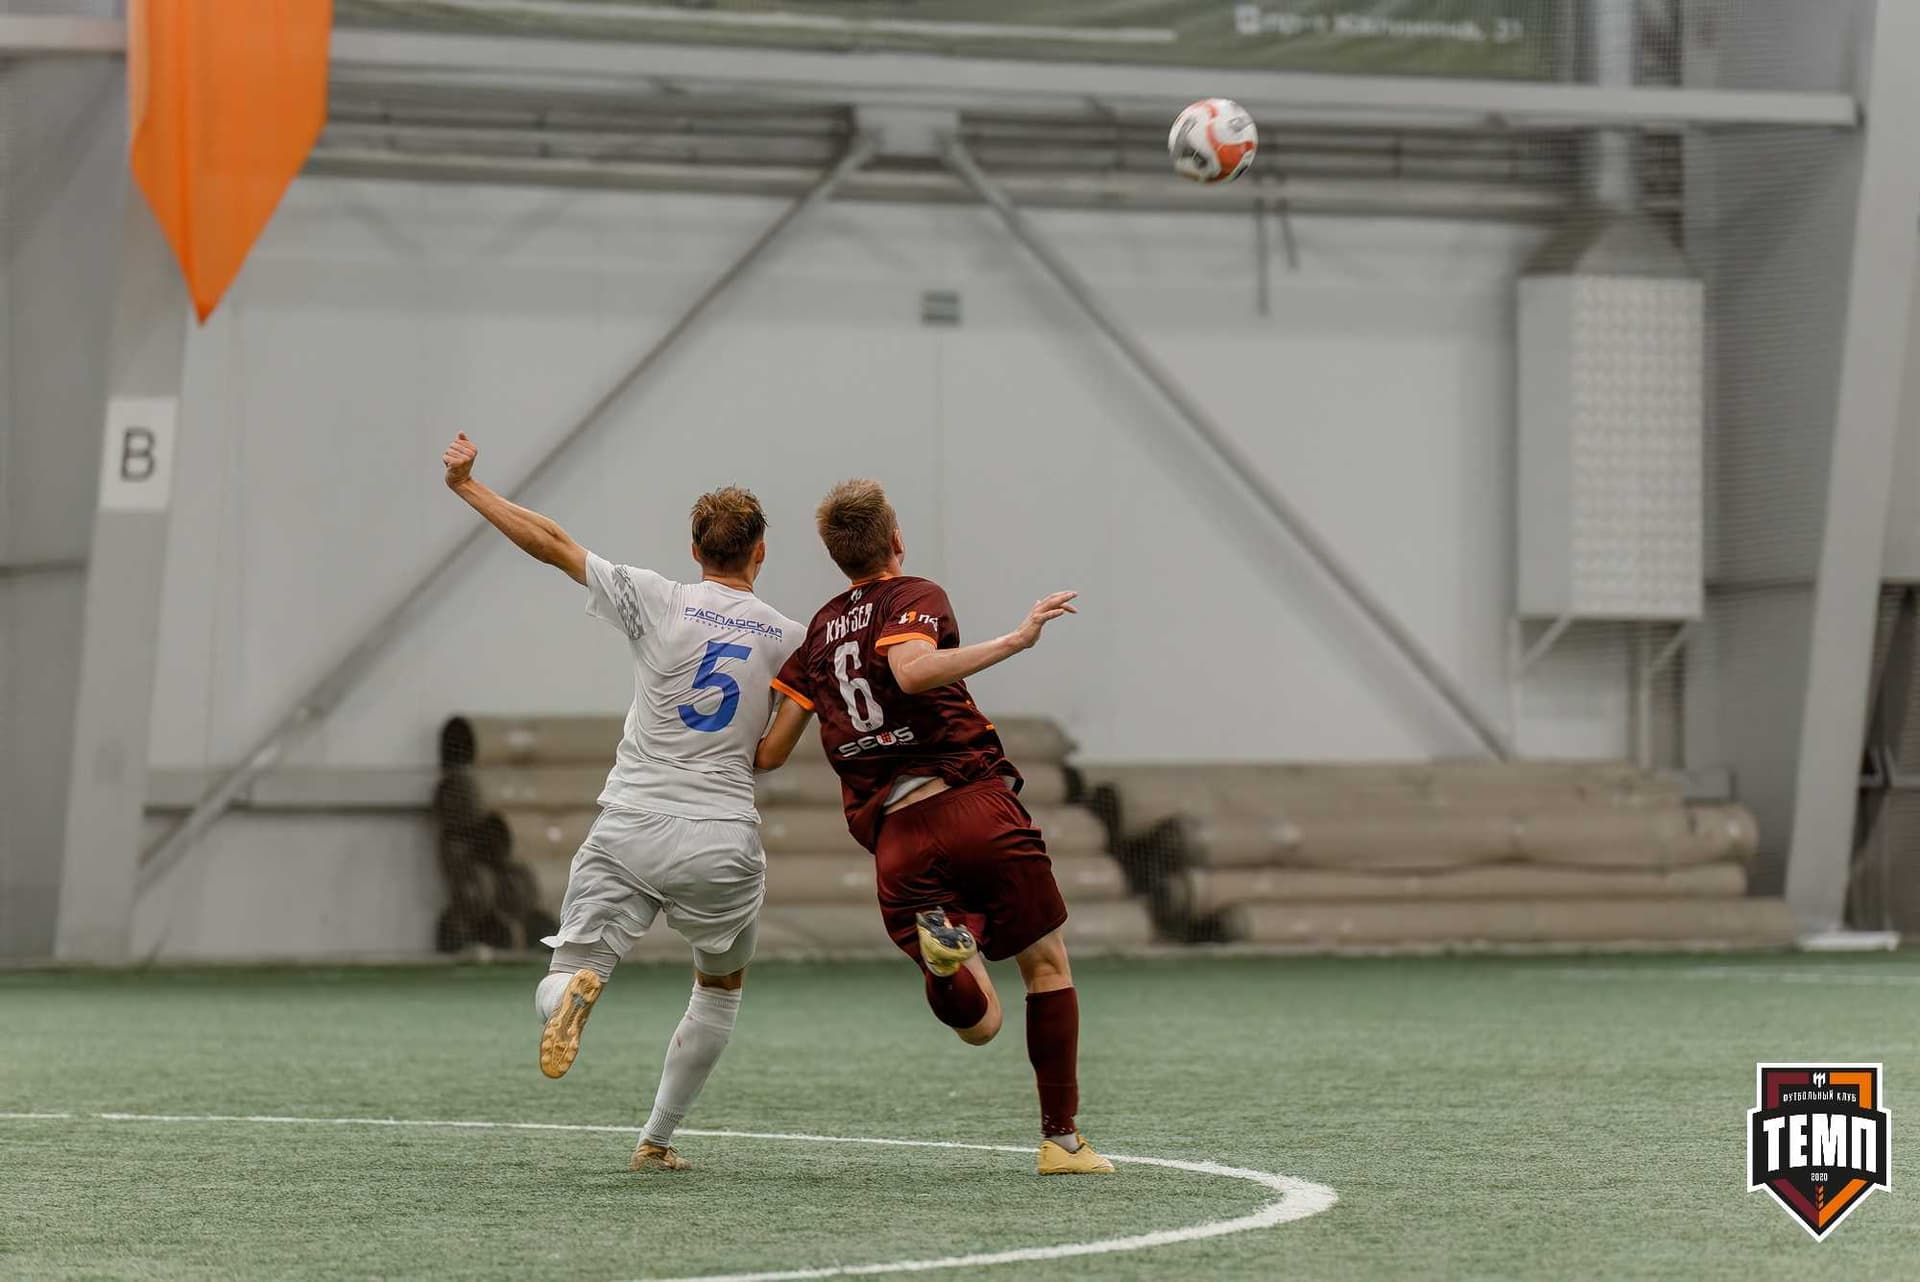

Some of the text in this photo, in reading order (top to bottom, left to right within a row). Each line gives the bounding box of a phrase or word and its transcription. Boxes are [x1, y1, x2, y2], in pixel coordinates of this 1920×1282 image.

[677, 640, 753, 732] 5
[834, 640, 883, 732] 6
[838, 726, 914, 757] SEUS
